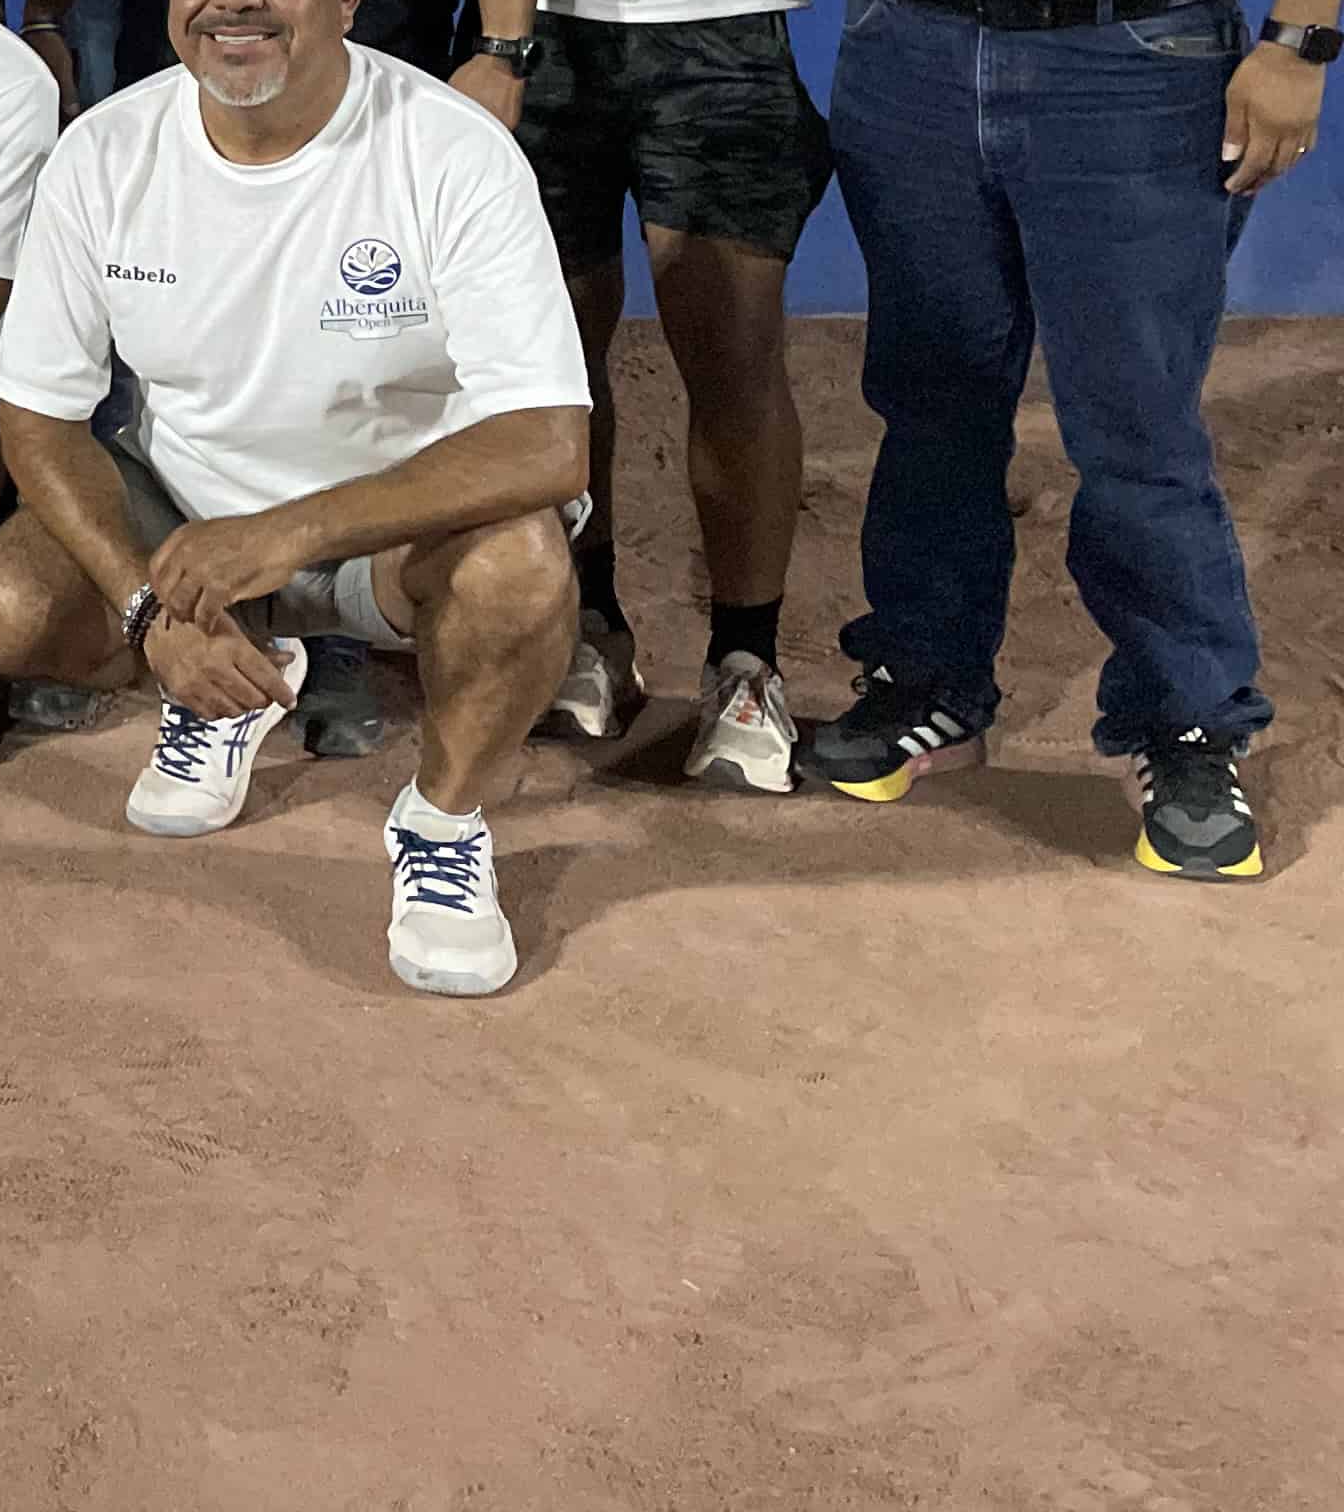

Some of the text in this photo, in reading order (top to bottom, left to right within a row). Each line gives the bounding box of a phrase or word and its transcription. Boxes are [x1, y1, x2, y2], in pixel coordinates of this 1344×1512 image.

[105, 263, 177, 285] Rabelo
[320, 297, 427, 318] Alberquita
[358, 316, 392, 330] Open
